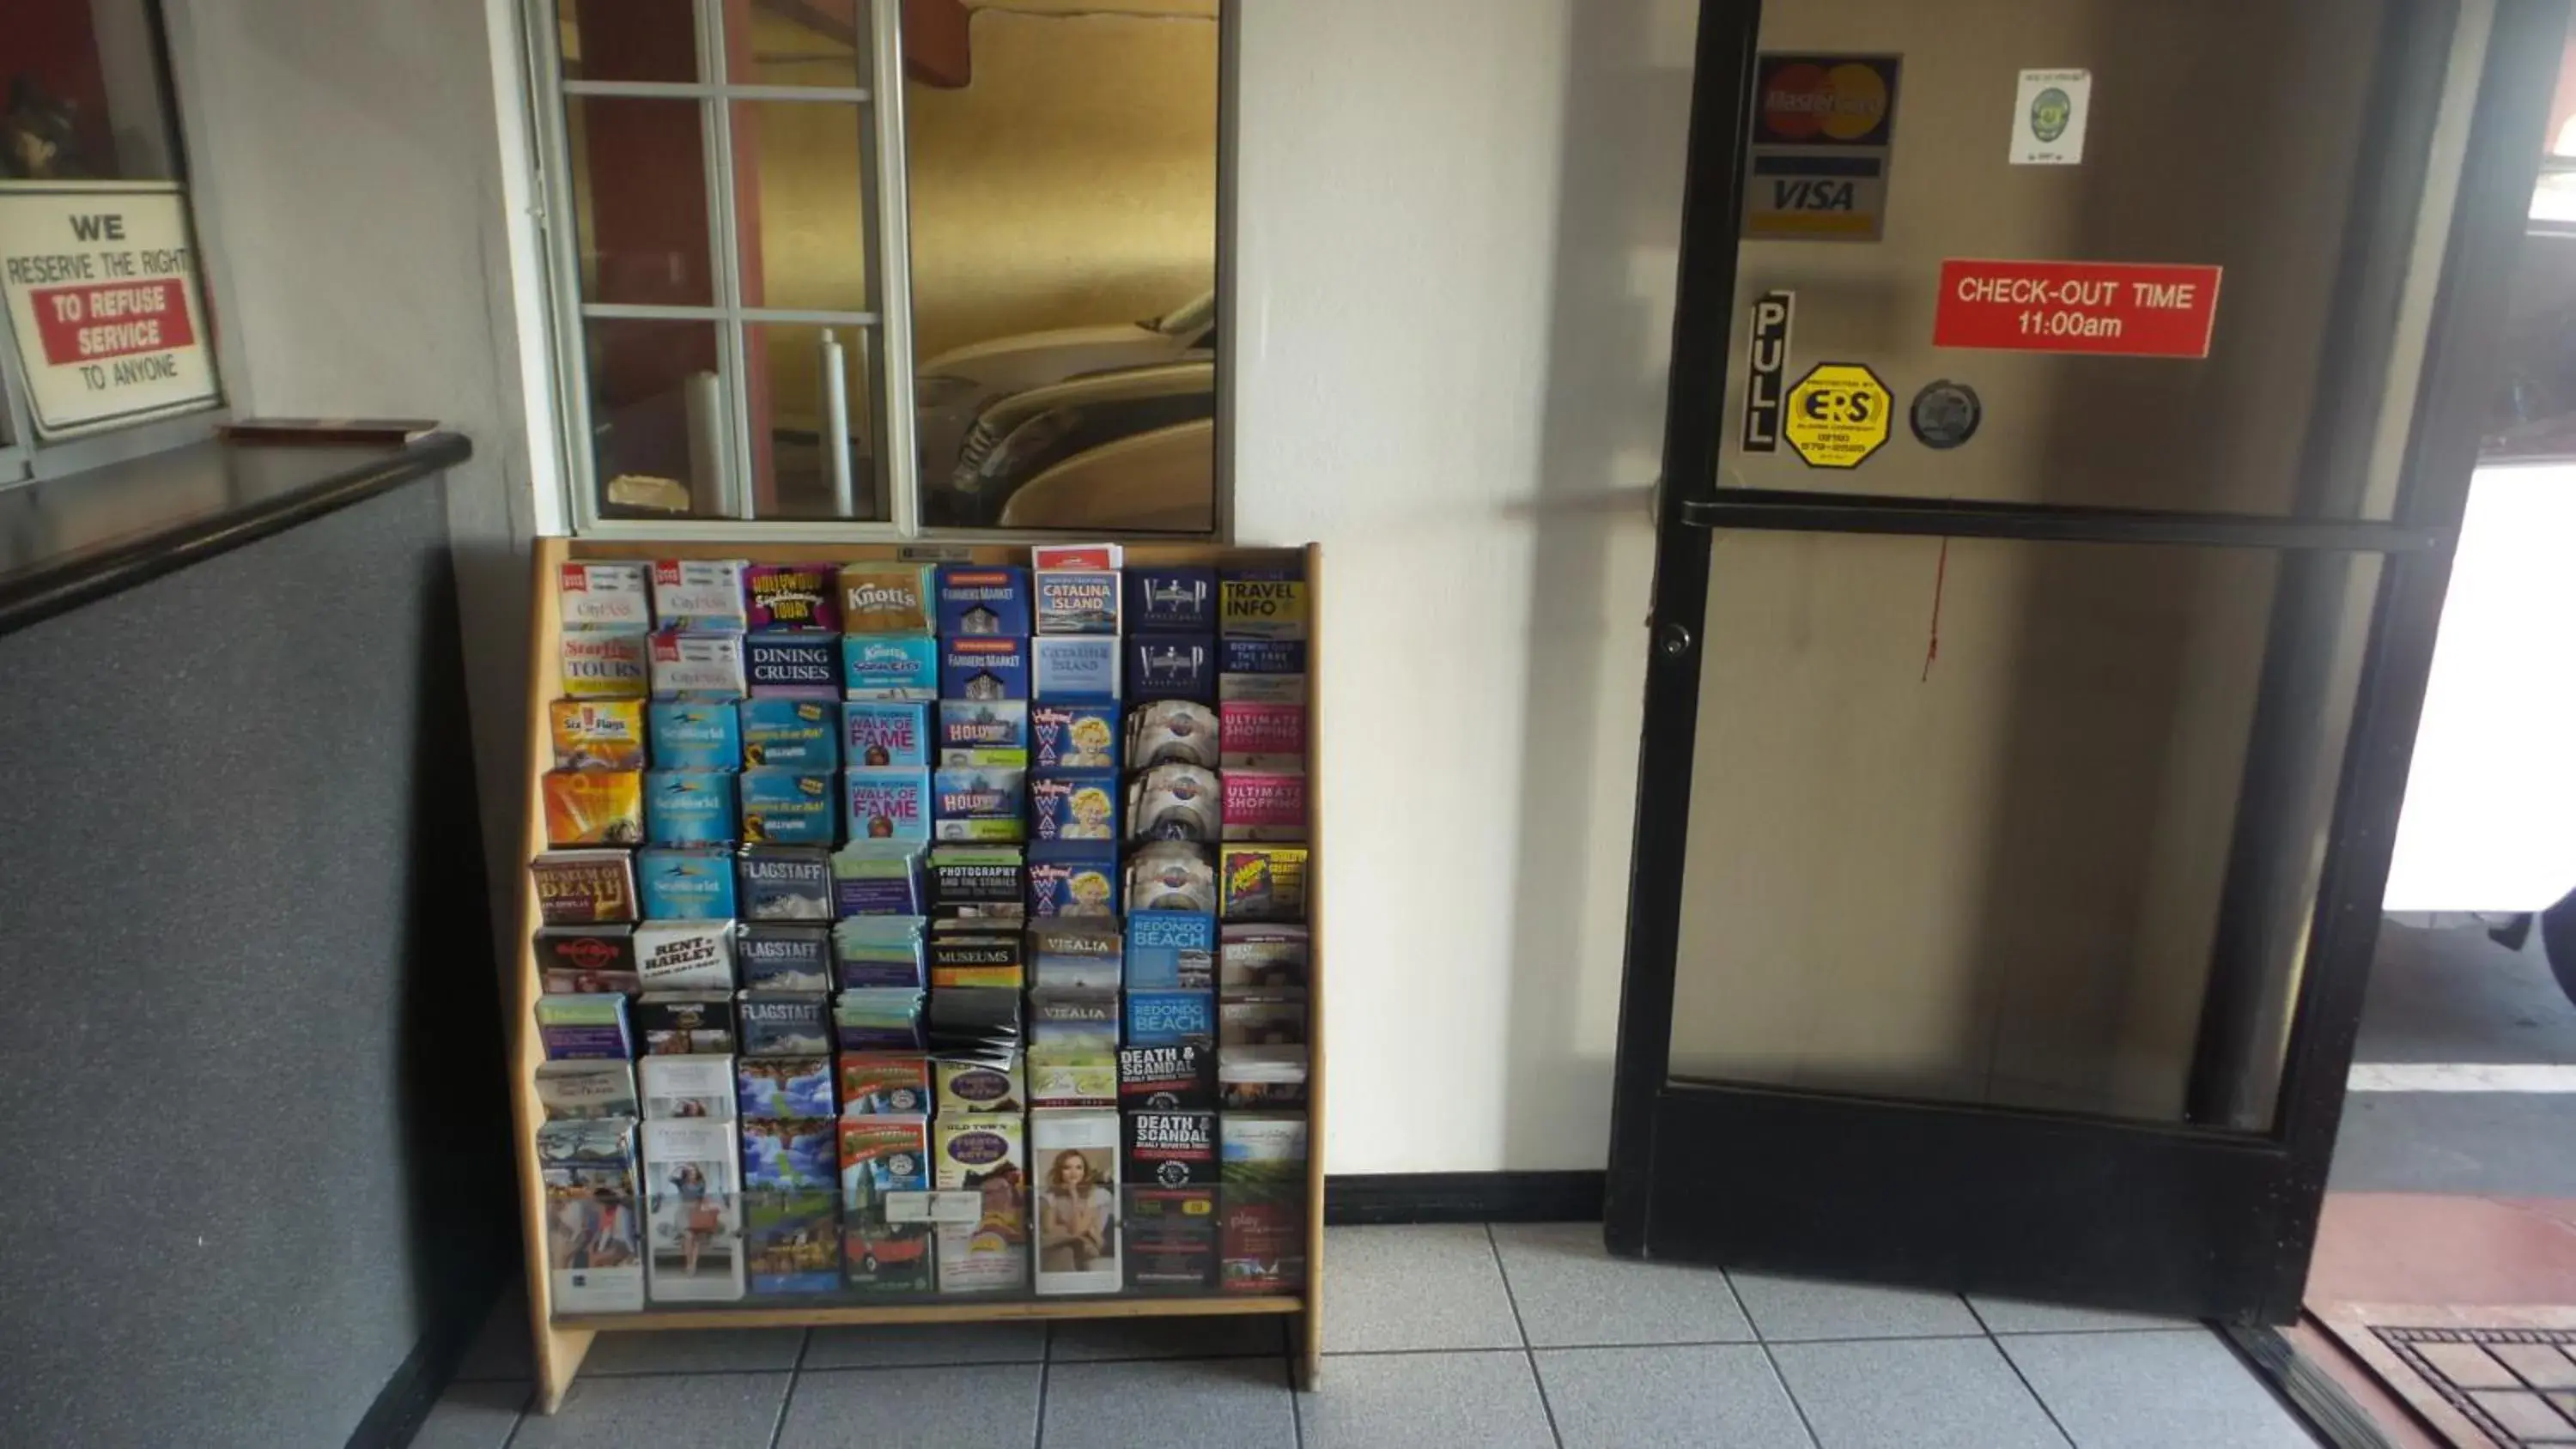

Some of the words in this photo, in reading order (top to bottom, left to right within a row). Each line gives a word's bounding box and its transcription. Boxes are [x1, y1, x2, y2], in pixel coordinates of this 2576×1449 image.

[1772, 179, 1855, 211] VISA
[69, 214, 125, 241] WE
[7, 253, 94, 285] RESERVE
[100, 252, 136, 277] THE
[141, 247, 190, 275] RIGHT
[1957, 276, 2118, 306] CHECK-OUT
[2133, 282, 2196, 310] TIME
[52, 294, 82, 323] TO
[90, 285, 166, 318] REFUSE
[2018, 311, 2123, 338] 11:00am
[78, 319, 161, 355] SERVICE
[80, 364, 106, 390] TO
[114, 354, 178, 385] ANYONE
[1749, 302, 1784, 444] PULL
[848, 583, 916, 609] Knott's
[1043, 585, 1111, 597] CATALINA
[1225, 583, 1296, 599] TRAVEL
[1052, 597, 1103, 609] ISLAND
[1226, 600, 1277, 616] INFO
[753, 648, 829, 663] DINING
[568, 660, 641, 677] TOURS
[755, 664, 829, 680] CRUISES
[851, 717, 889, 730] WALK
[895, 718, 914, 730] OF
[1225, 714, 1299, 724] ULTIMATE
[852, 731, 915, 748] FAME
[853, 788, 894, 800] WALK
[897, 788, 918, 800] OF
[1227, 785, 1302, 797] ULTIMATE
[854, 801, 918, 818] FAME
[1227, 798, 1302, 808] SHOPPING
[741, 862, 820, 879] FLAGSTAFF
[939, 866, 1017, 876] PHOTOGRAPHY
[540, 880, 621, 898] DEATH
[1134, 921, 1206, 933] REDONDO
[1048, 938, 1109, 952] VISALIA
[1134, 931, 1205, 948] BEACH
[739, 940, 817, 957] FLAGSTAFF
[645, 946, 715, 970] HARLEY
[939, 951, 1009, 963] MUSEUMS
[741, 1003, 820, 1020] FLAGSTAFF
[1044, 1007, 1107, 1019] VISALIA
[1135, 1005, 1203, 1016] REDONDO
[1136, 1016, 1206, 1031] BEACH
[1121, 1047, 1177, 1064] DEATH
[1183, 1046, 1194, 1060] &
[1121, 1060, 1196, 1076] SCANDAL
[1137, 1115, 1193, 1130] DEATH
[1137, 1129, 1210, 1143] SCANDAL
